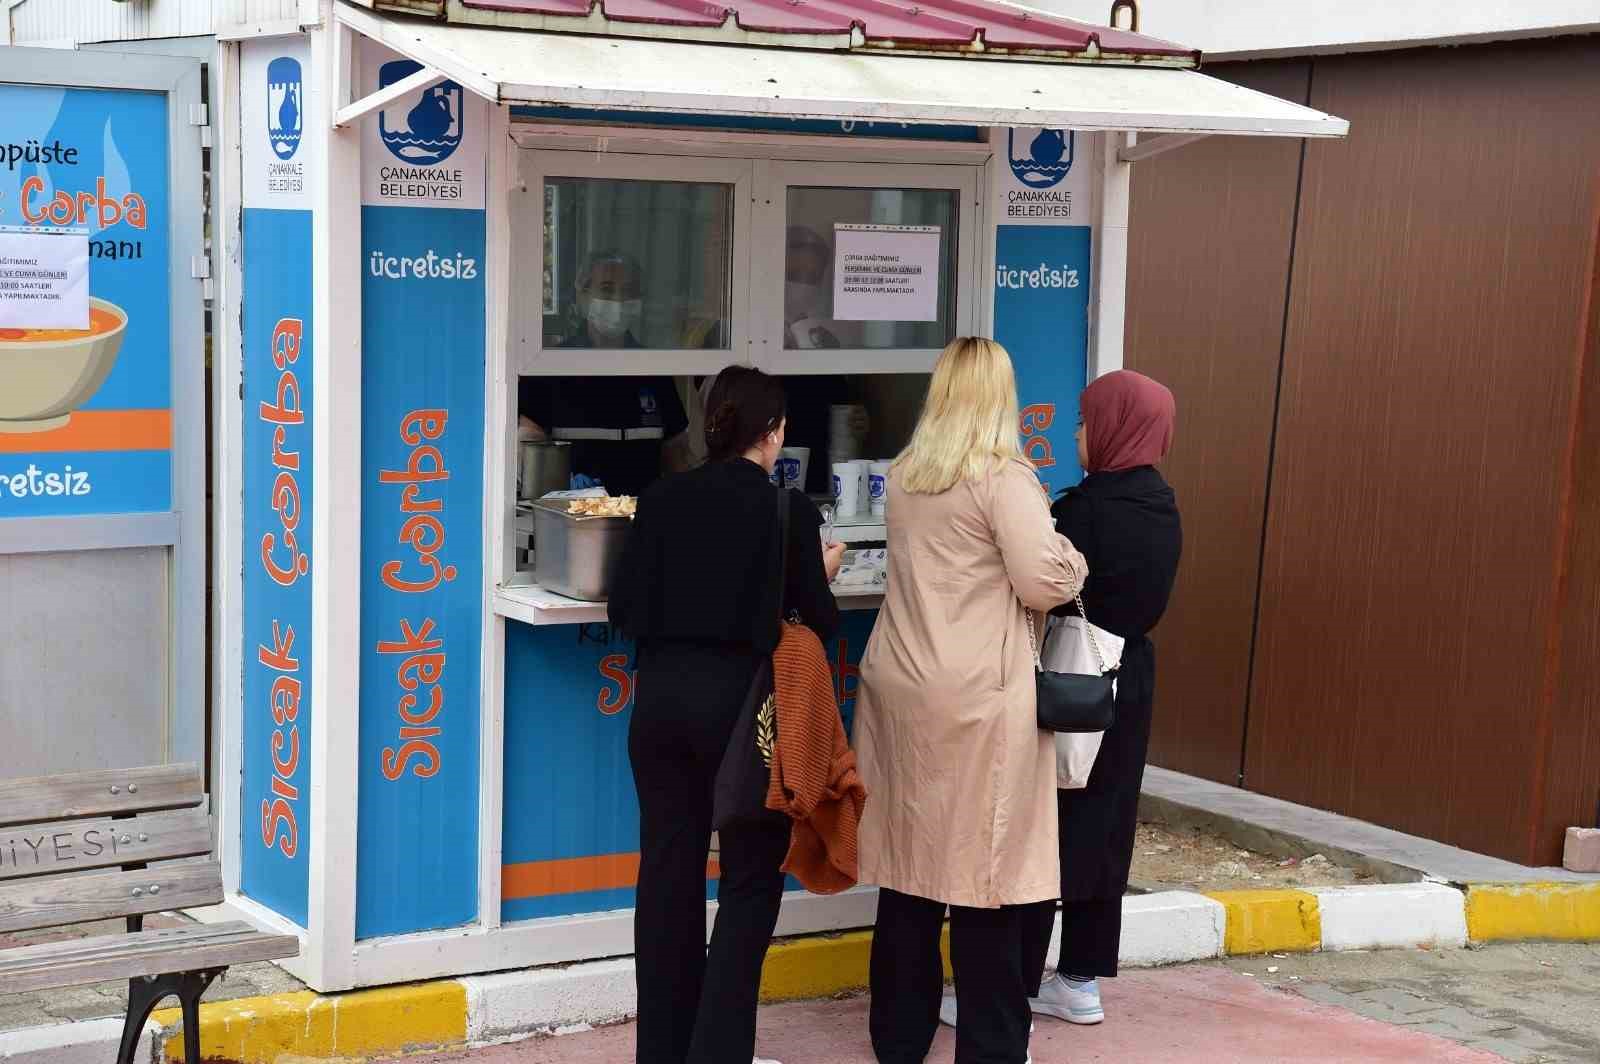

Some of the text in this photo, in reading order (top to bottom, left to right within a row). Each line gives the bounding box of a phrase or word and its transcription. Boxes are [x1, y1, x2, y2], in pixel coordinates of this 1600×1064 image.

[380, 166, 463, 181] ÇANAKKALE
[380, 182, 463, 198] BELEDİYESİ
[1008, 190, 1072, 203] ÇANAKKALE
[1008, 203, 1071, 217] BELEDİYESİ
[370, 249, 477, 280] ücretsiz
[996, 262, 1079, 289] ücretsiz
[258, 317, 308, 859] Sıcak Çorba
[376, 408, 457, 782] Sıcak Çorba
